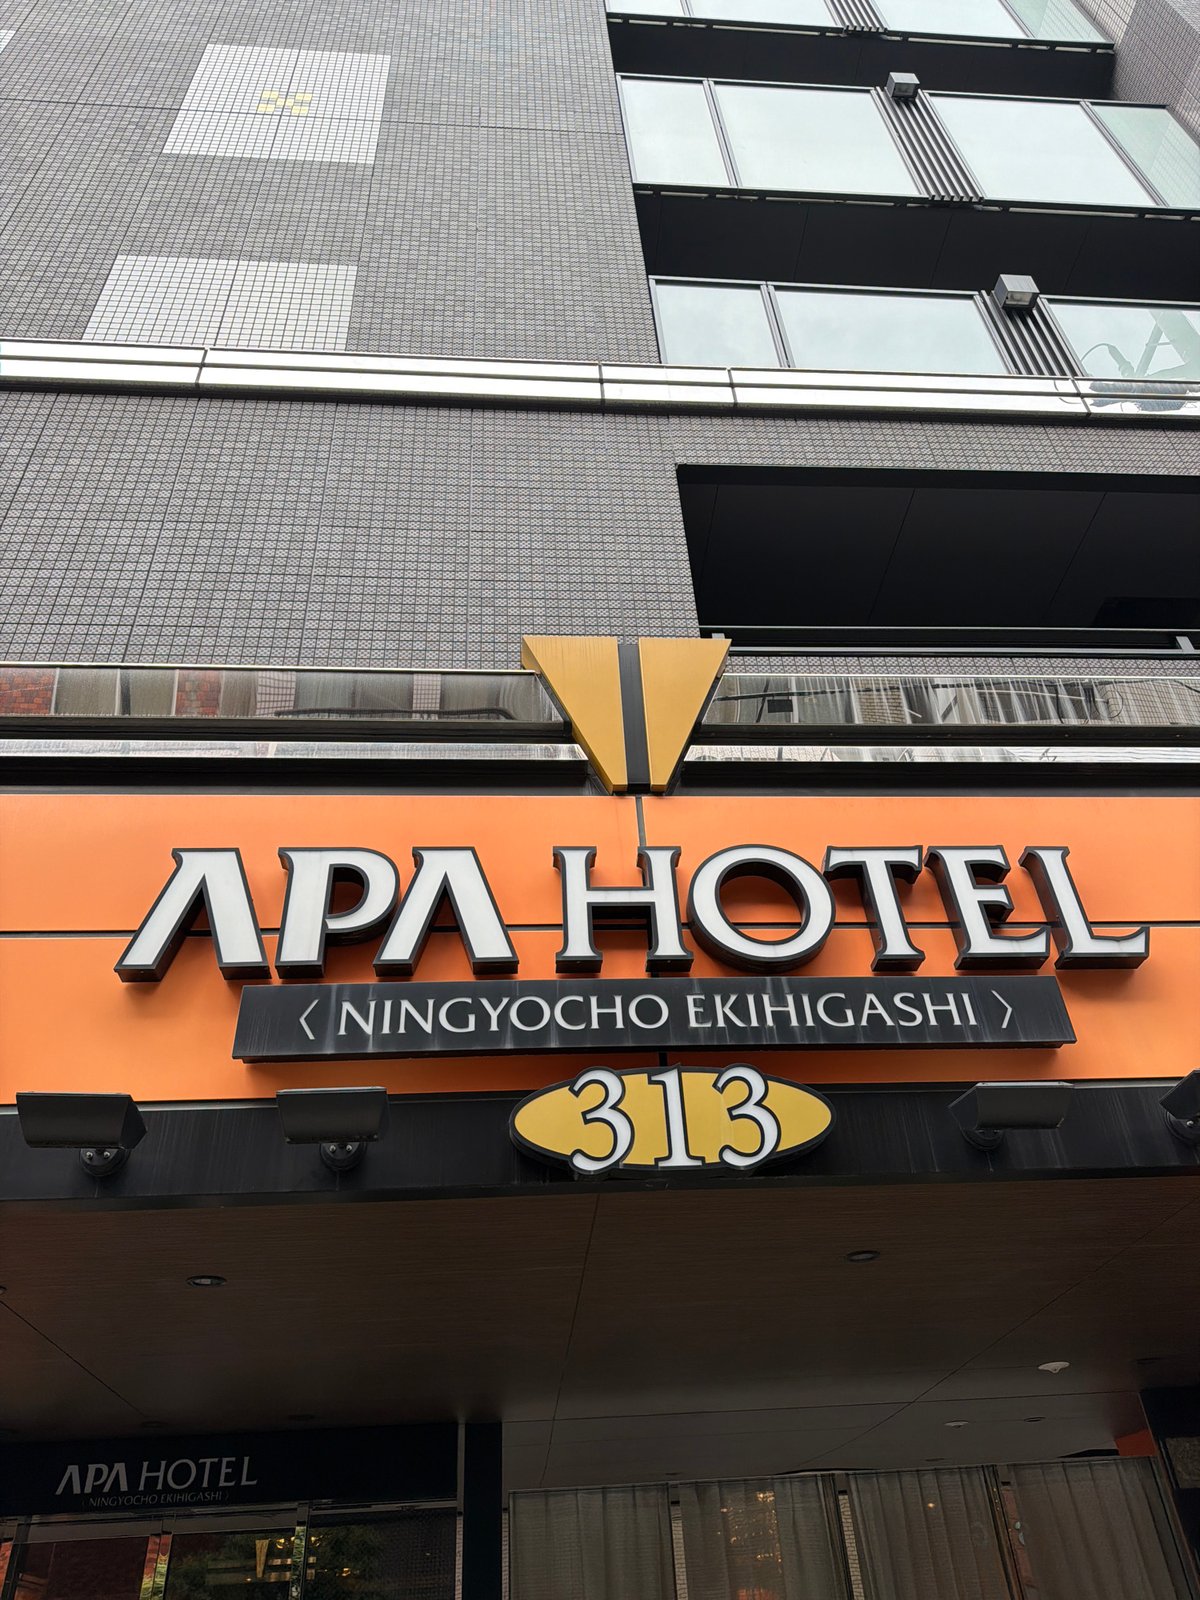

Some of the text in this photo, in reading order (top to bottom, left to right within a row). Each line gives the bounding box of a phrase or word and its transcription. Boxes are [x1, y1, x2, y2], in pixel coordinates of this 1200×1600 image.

[115, 843, 1149, 978] APA HOTEL
[337, 991, 978, 1036] NINGYOCHO EKIHIGASHI
[569, 1066, 782, 1173] 313
[55, 1456, 258, 1495] APA HOTEL
[89, 1491, 222, 1507] NINGYOCHO EKIHIGASHI
